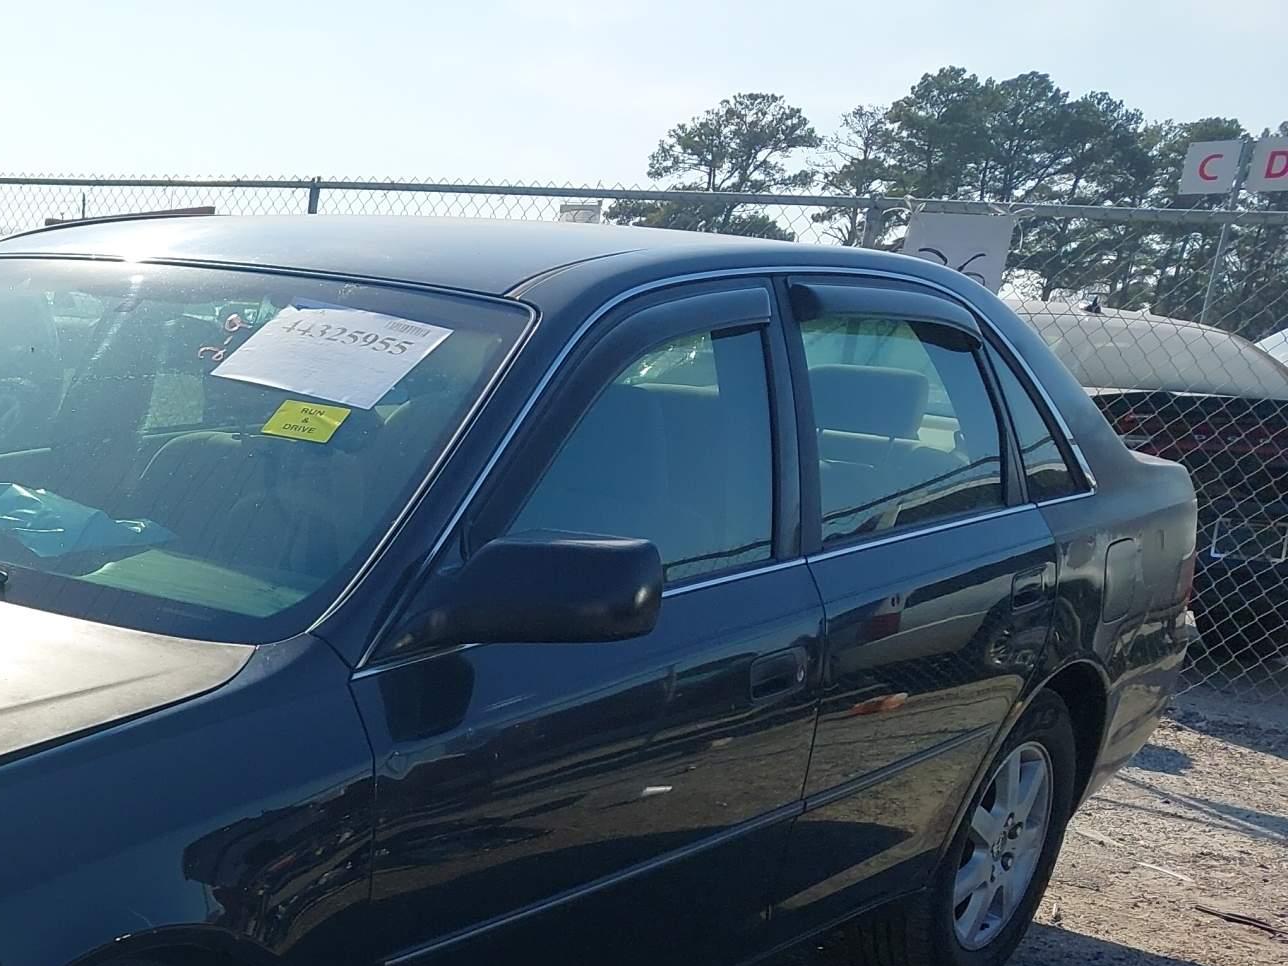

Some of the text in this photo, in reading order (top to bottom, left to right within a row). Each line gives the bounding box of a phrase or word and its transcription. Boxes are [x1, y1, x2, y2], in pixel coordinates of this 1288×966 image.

[1198, 153, 1224, 181] C
[1263, 150, 1288, 179] D
[281, 318, 415, 356] 44325955
[300, 406, 326, 417] RUN
[282, 422, 316, 434] DRIVE
